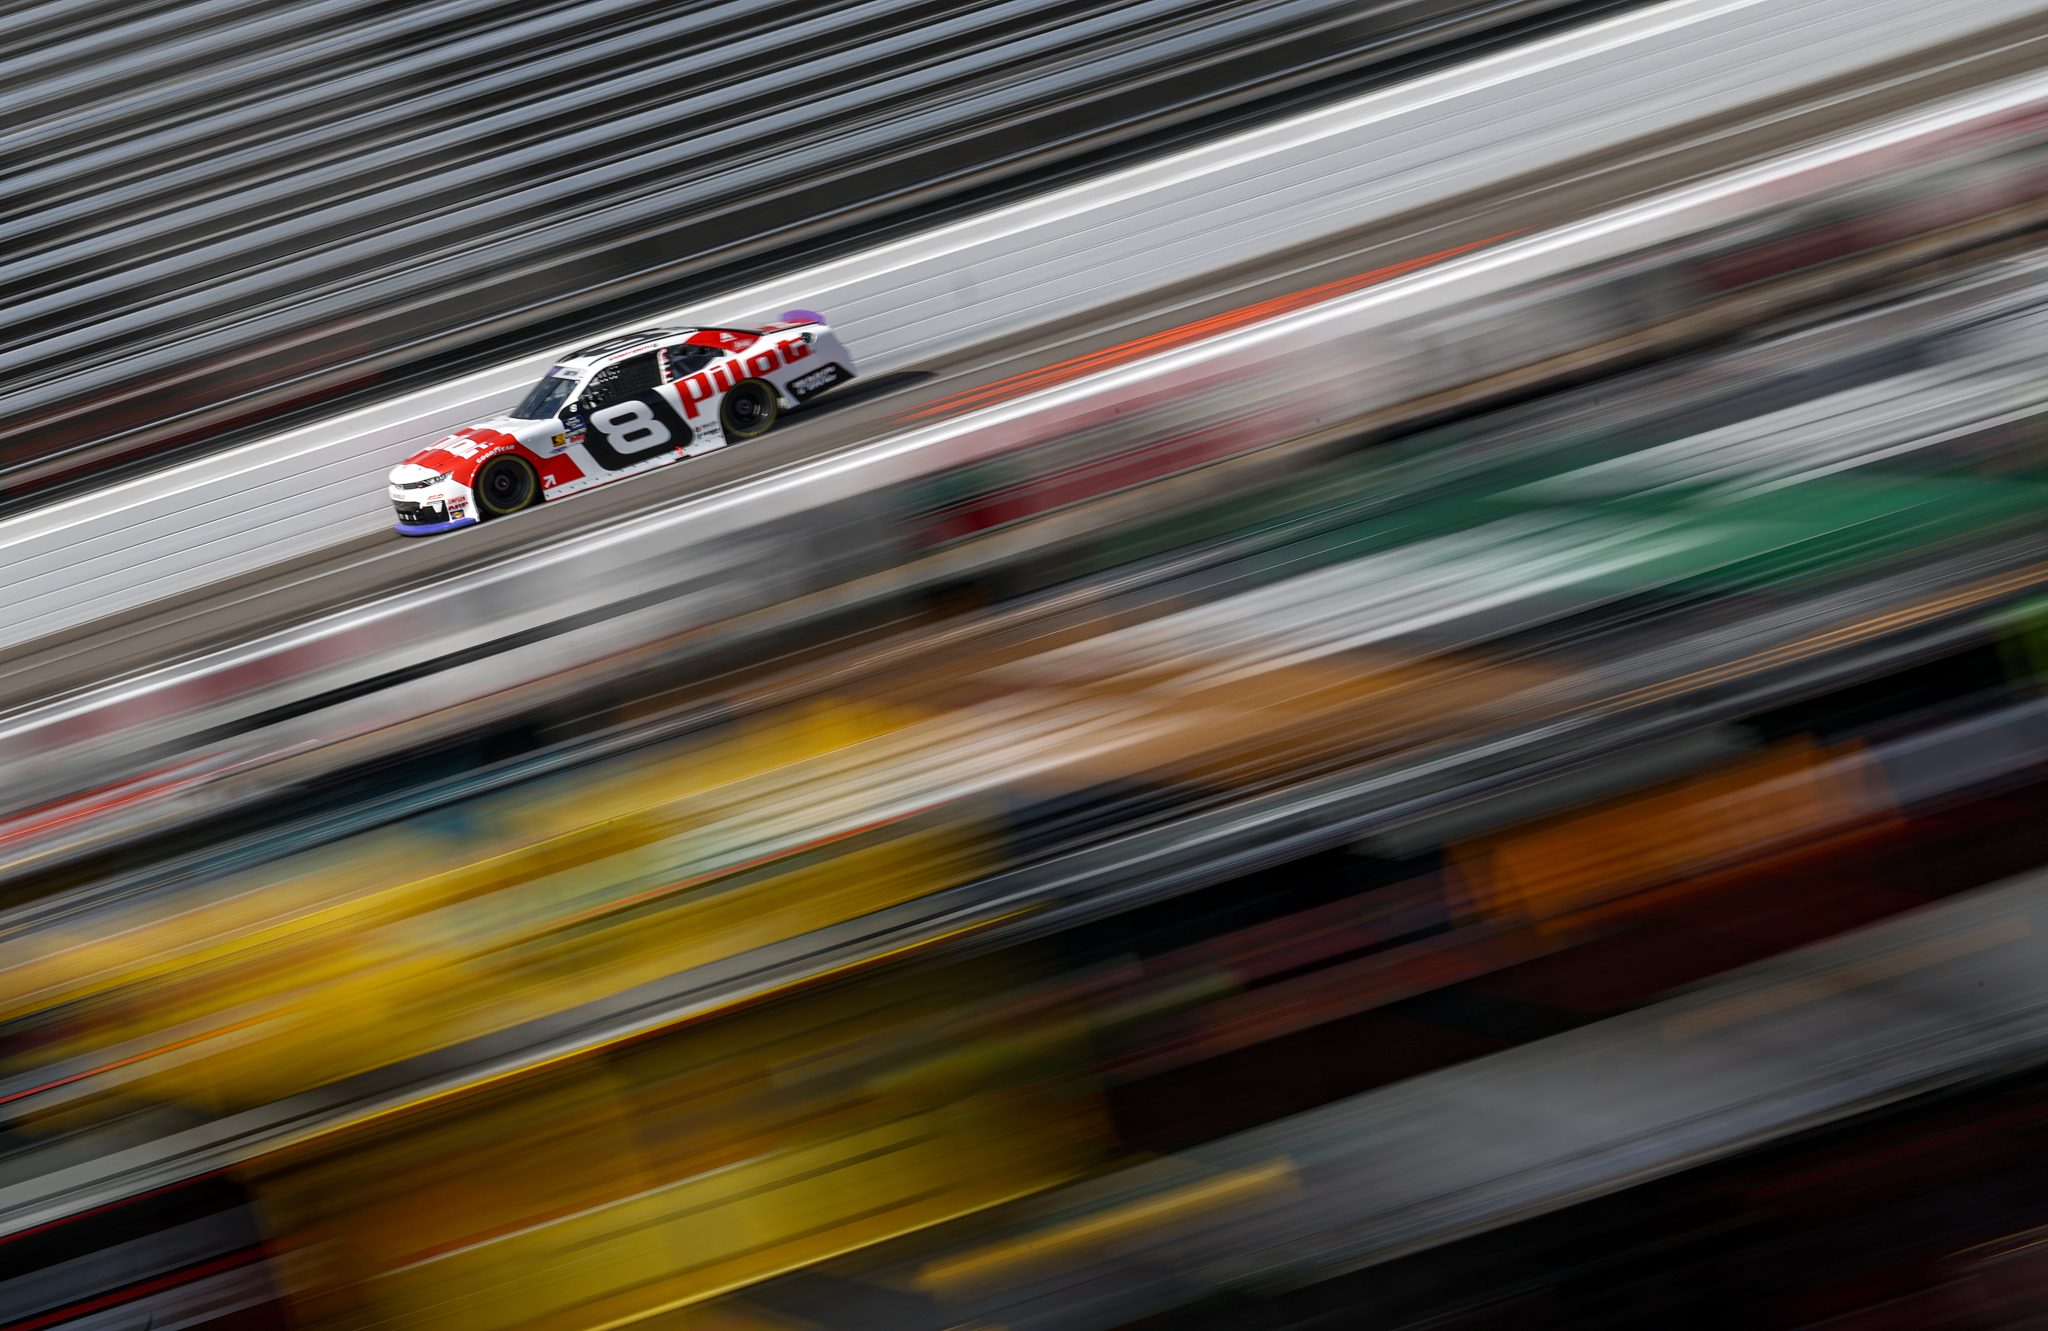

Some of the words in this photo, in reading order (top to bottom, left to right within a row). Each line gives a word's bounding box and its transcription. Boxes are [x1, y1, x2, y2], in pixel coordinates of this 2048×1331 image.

[674, 336, 813, 420] pilot
[475, 443, 516, 464] GOODYEAR
[589, 400, 672, 455] 8
